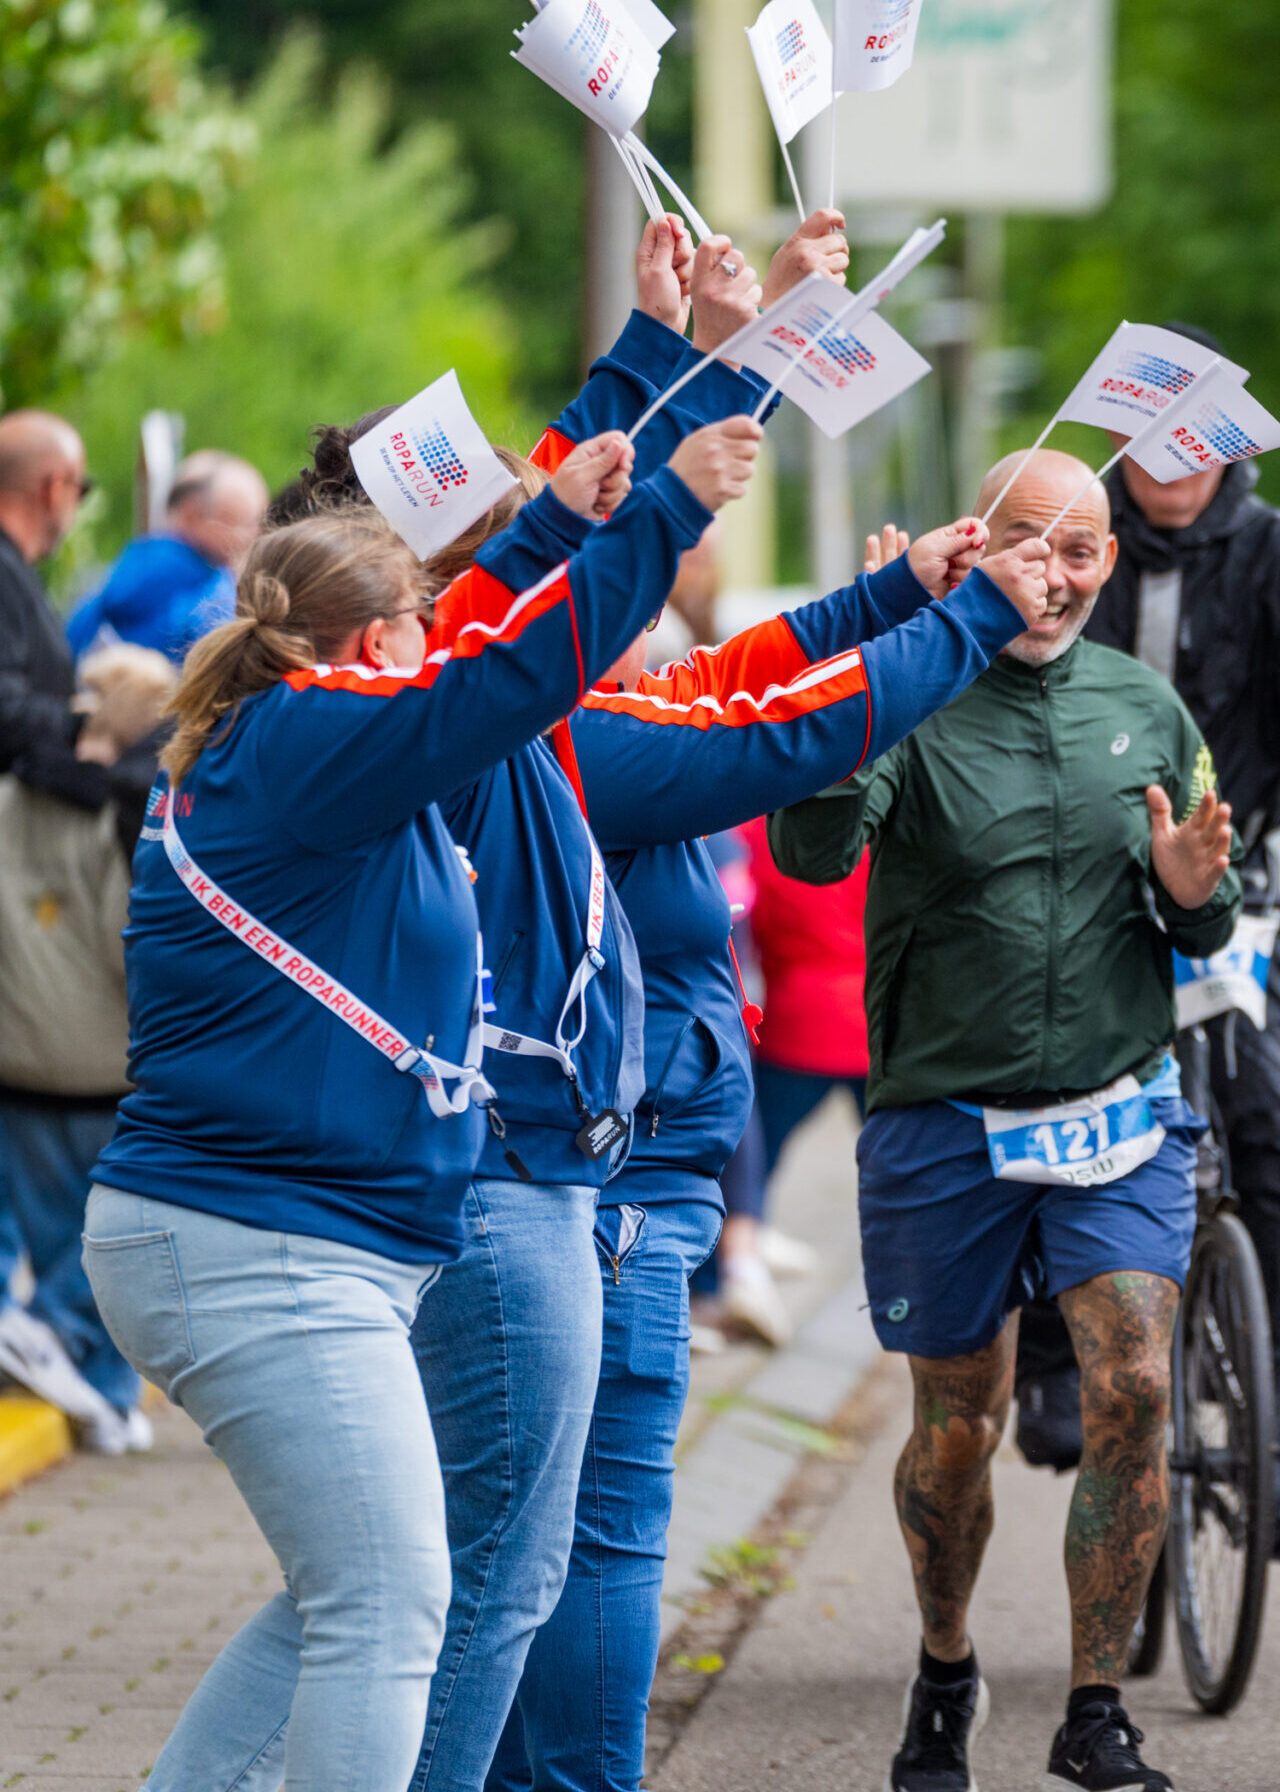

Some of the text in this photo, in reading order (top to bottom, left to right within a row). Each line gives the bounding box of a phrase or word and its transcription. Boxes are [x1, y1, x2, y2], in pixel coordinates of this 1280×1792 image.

[390, 432, 445, 507] ROPARUN
[190, 875, 405, 1057] IK BEN EEN ROPARUNNER
[593, 1125, 620, 1154] ROPARUN
